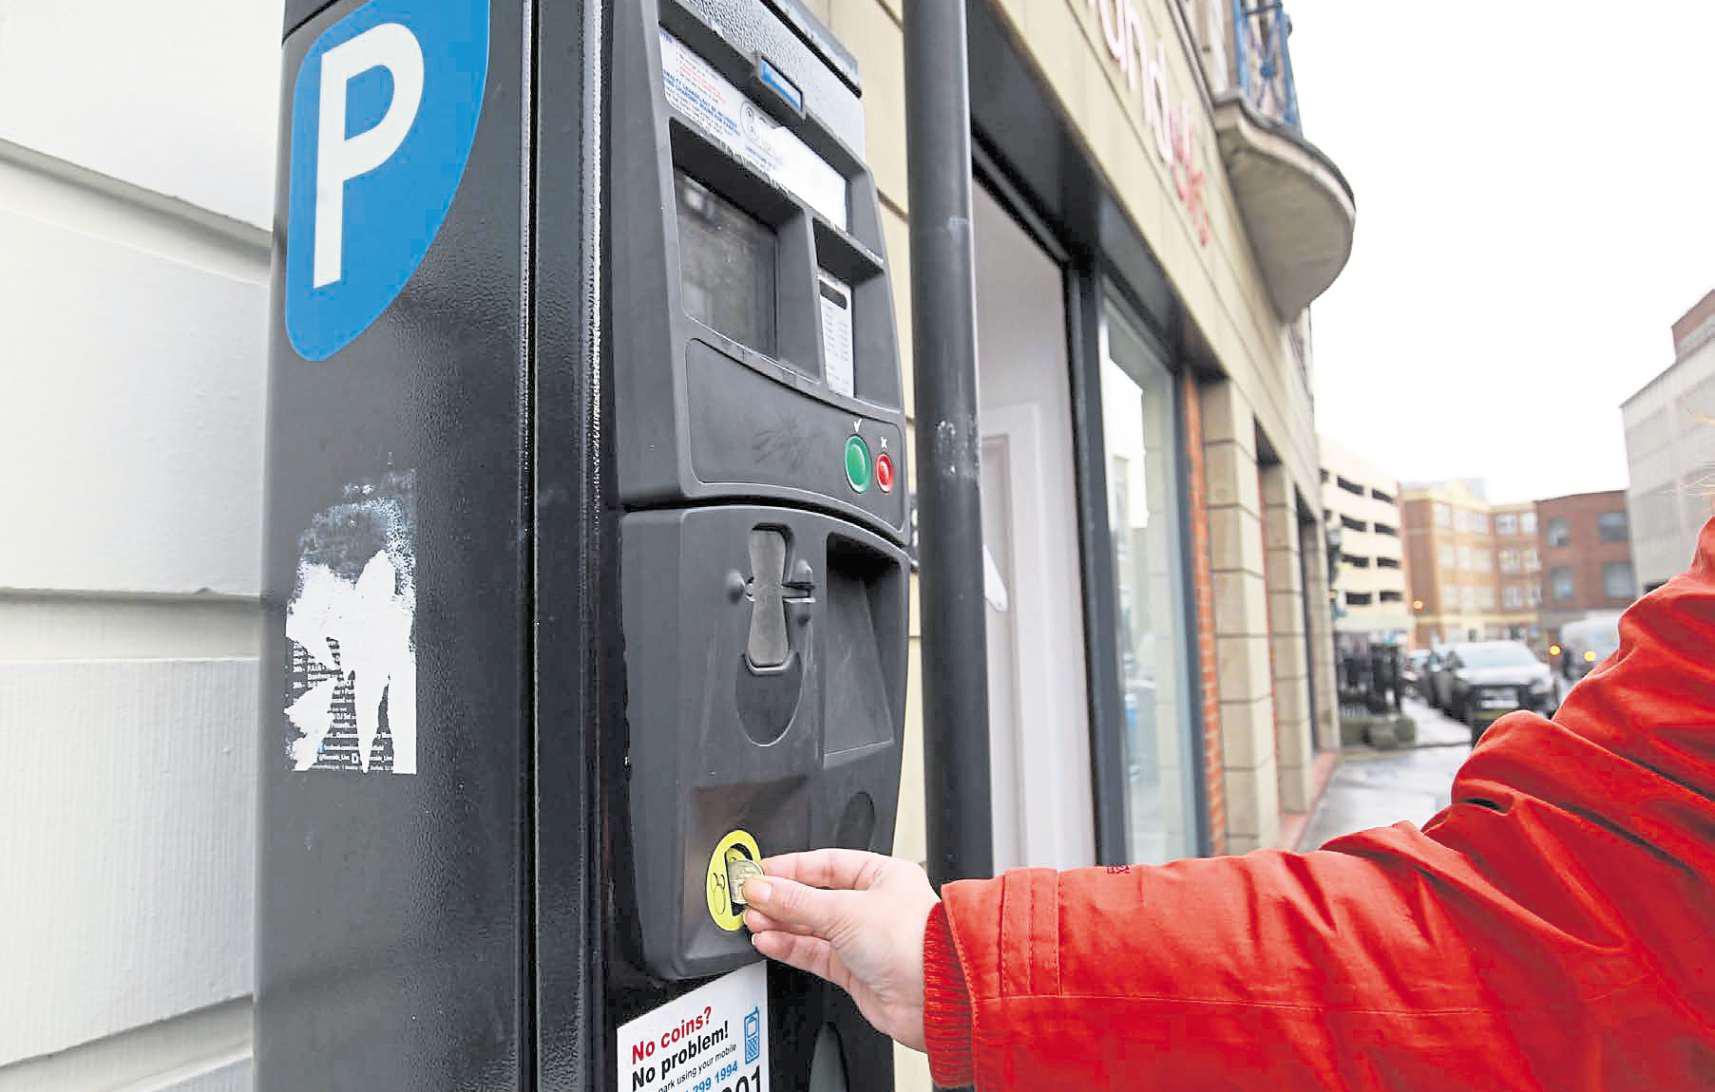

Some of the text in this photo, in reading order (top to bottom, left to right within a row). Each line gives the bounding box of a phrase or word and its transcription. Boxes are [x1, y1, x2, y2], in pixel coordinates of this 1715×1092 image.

[313, 23, 424, 289] P
[631, 1006, 712, 1065] No coins?
[631, 1020, 729, 1092] No problem!
[676, 1068, 697, 1086] using
[698, 1058, 714, 1075] your
[715, 1044, 737, 1061] mobile
[714, 1060, 738, 1083] 1994
[721, 1065, 761, 1092] 01
